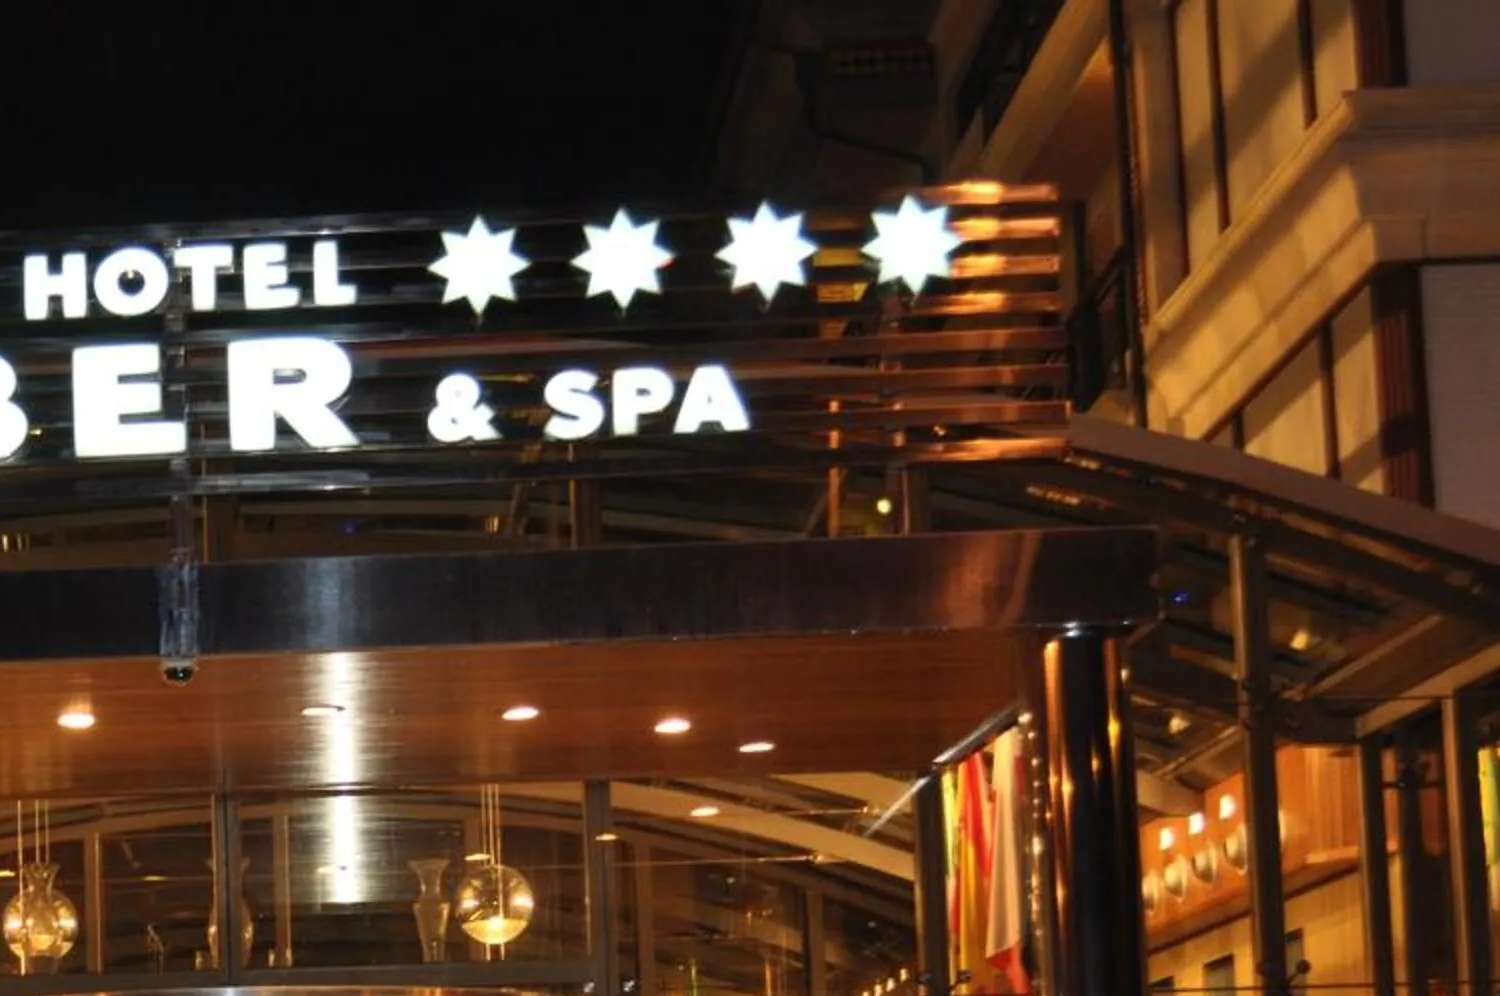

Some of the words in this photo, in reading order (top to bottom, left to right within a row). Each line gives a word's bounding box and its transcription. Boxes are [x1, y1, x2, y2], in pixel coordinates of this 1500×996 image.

[23, 241, 357, 321] HOTEL
[426, 372, 499, 443] &
[543, 364, 750, 440] SPA
